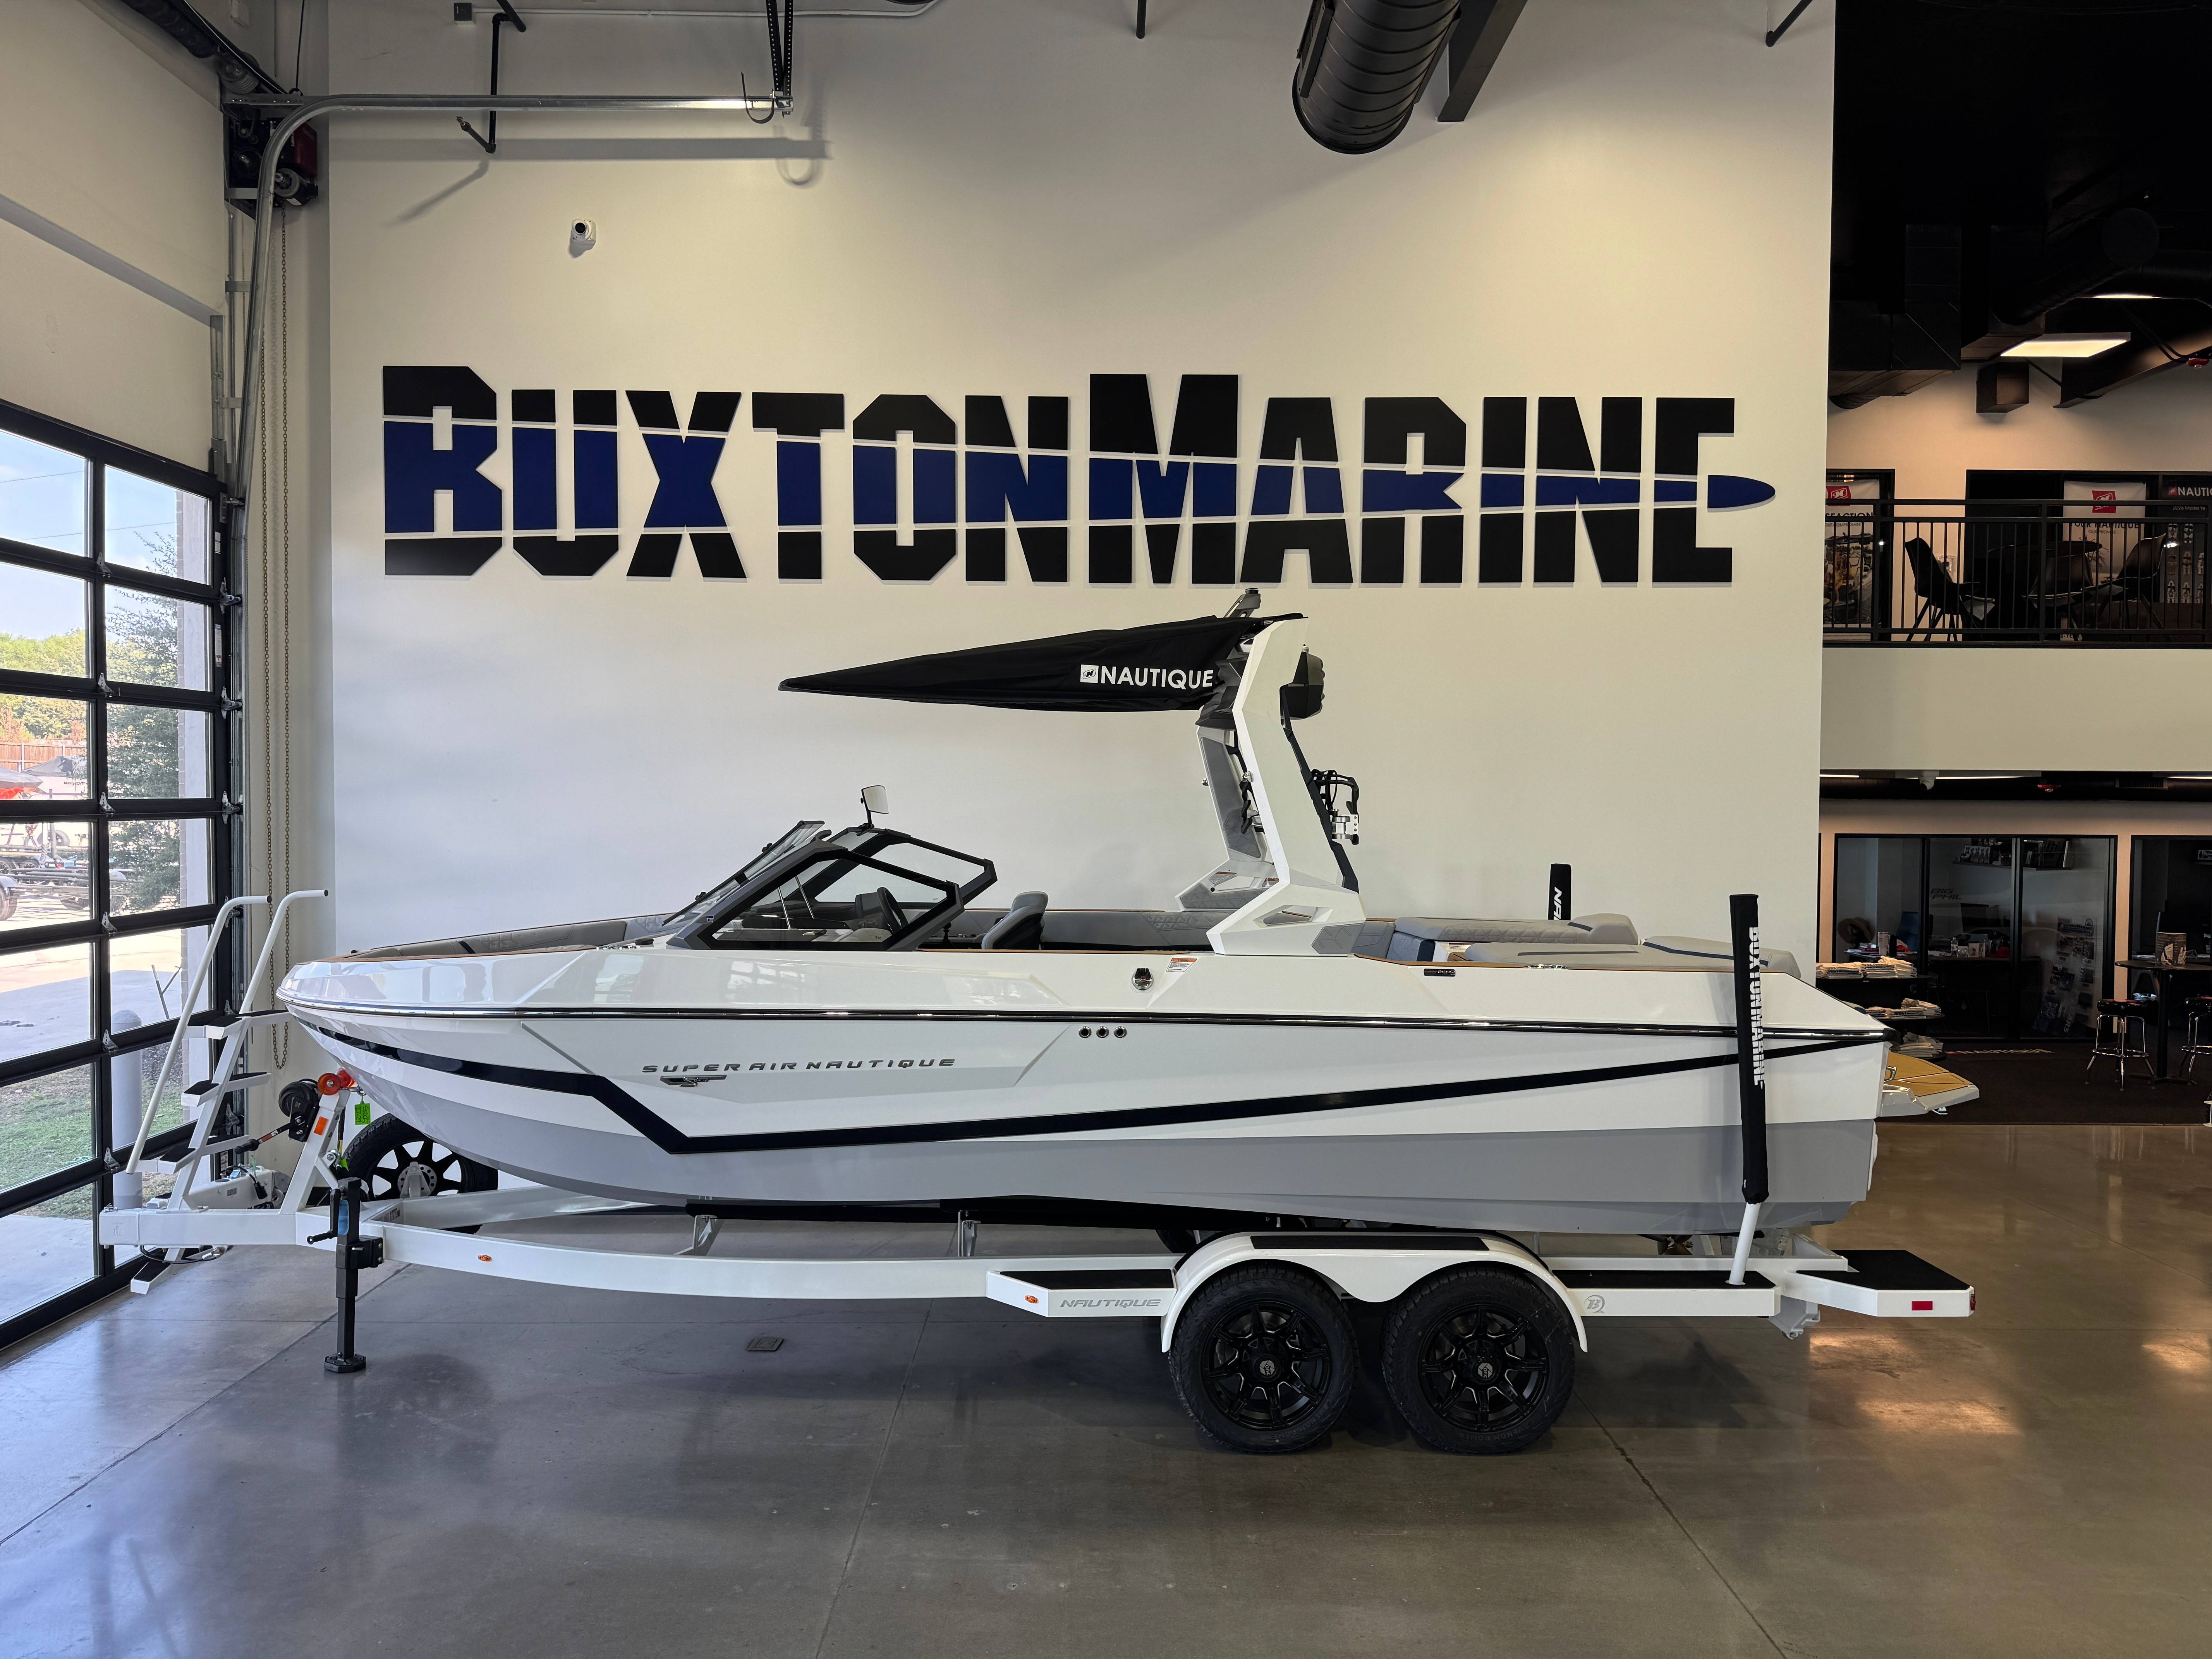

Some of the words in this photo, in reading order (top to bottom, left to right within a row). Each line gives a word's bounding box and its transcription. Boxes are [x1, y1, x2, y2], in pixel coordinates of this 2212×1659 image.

[1101, 666, 1214, 690] NAUTIQUE
[1554, 887, 1562, 920] NA
[642, 1063, 740, 1073] SUPER
[748, 1062, 797, 1071] AIR
[806, 1058, 955, 1070] NAUTIQUE
[1060, 1299, 1161, 1308] NAUTIQUE
